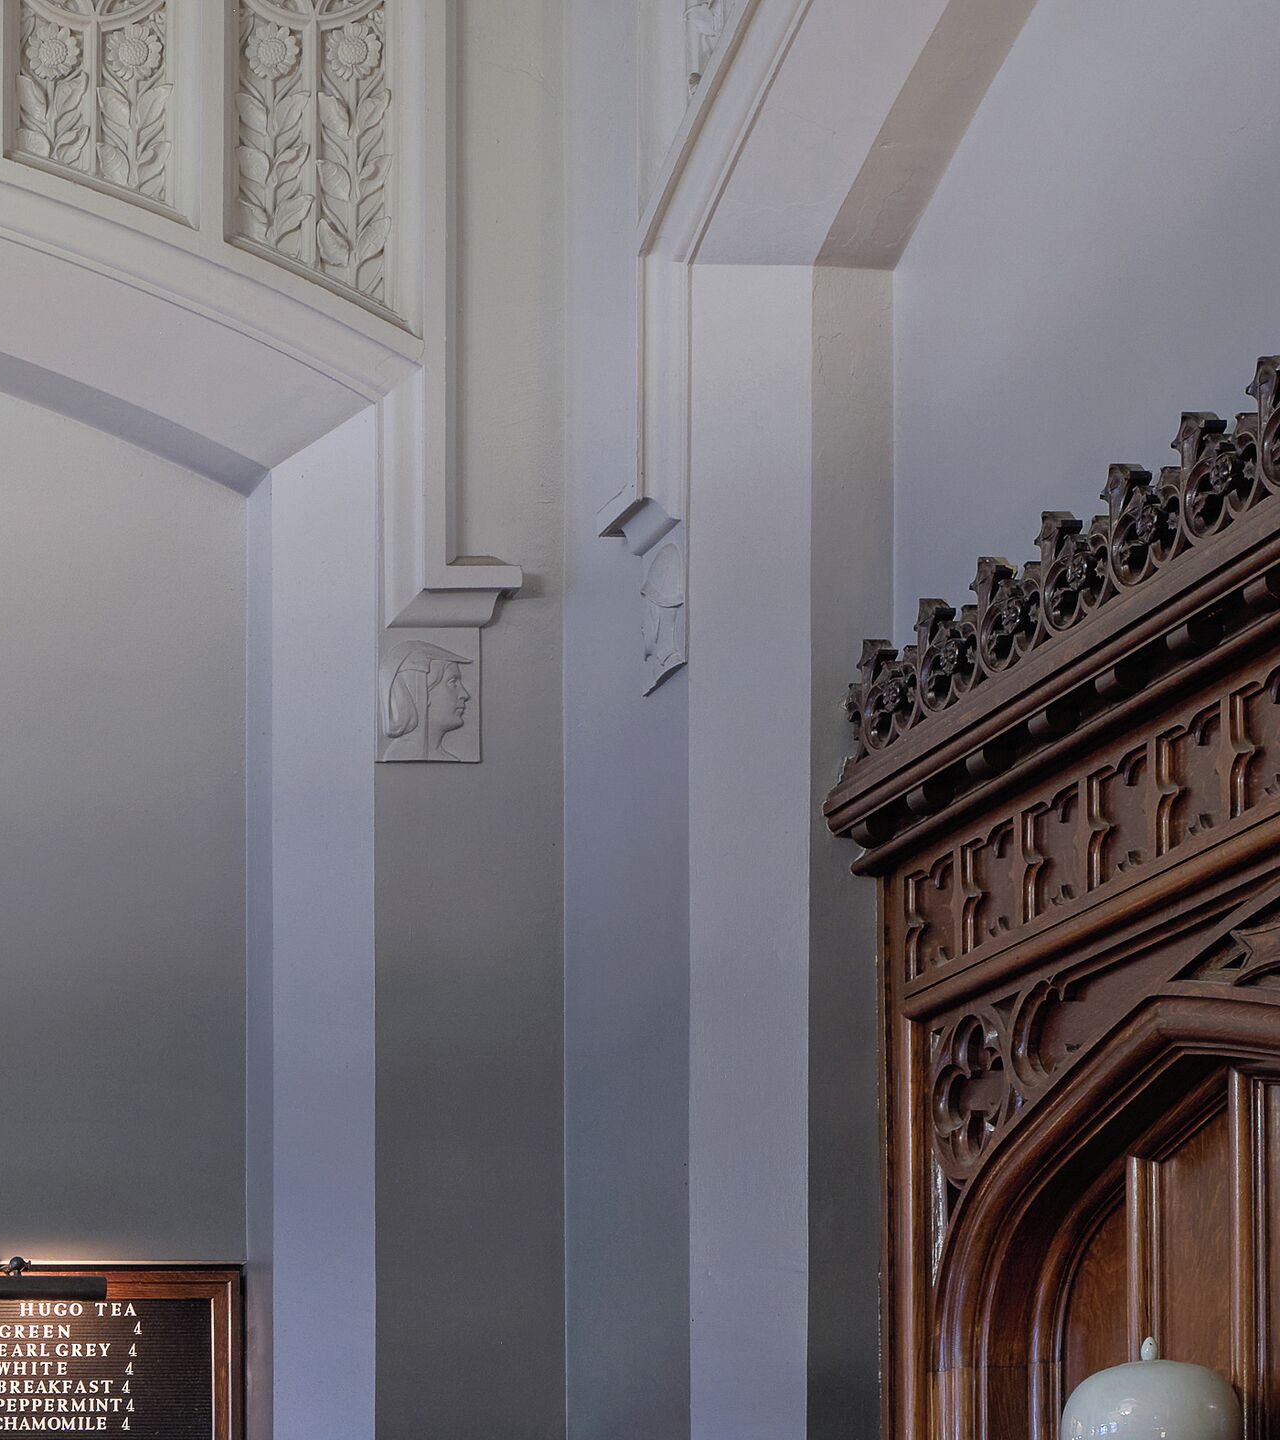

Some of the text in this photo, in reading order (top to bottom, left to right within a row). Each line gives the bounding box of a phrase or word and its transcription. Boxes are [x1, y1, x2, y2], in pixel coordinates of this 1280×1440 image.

[20, 1303, 137, 1317] HUGO TEA
[133, 1321, 143, 1335] 4
[55, 1343, 111, 1357] GREY
[128, 1344, 138, 1357] 4
[125, 1362, 134, 1376] 4
[122, 1380, 131, 1394] 4
[126, 1398, 135, 1412] 4
[122, 1417, 131, 1431] 4
